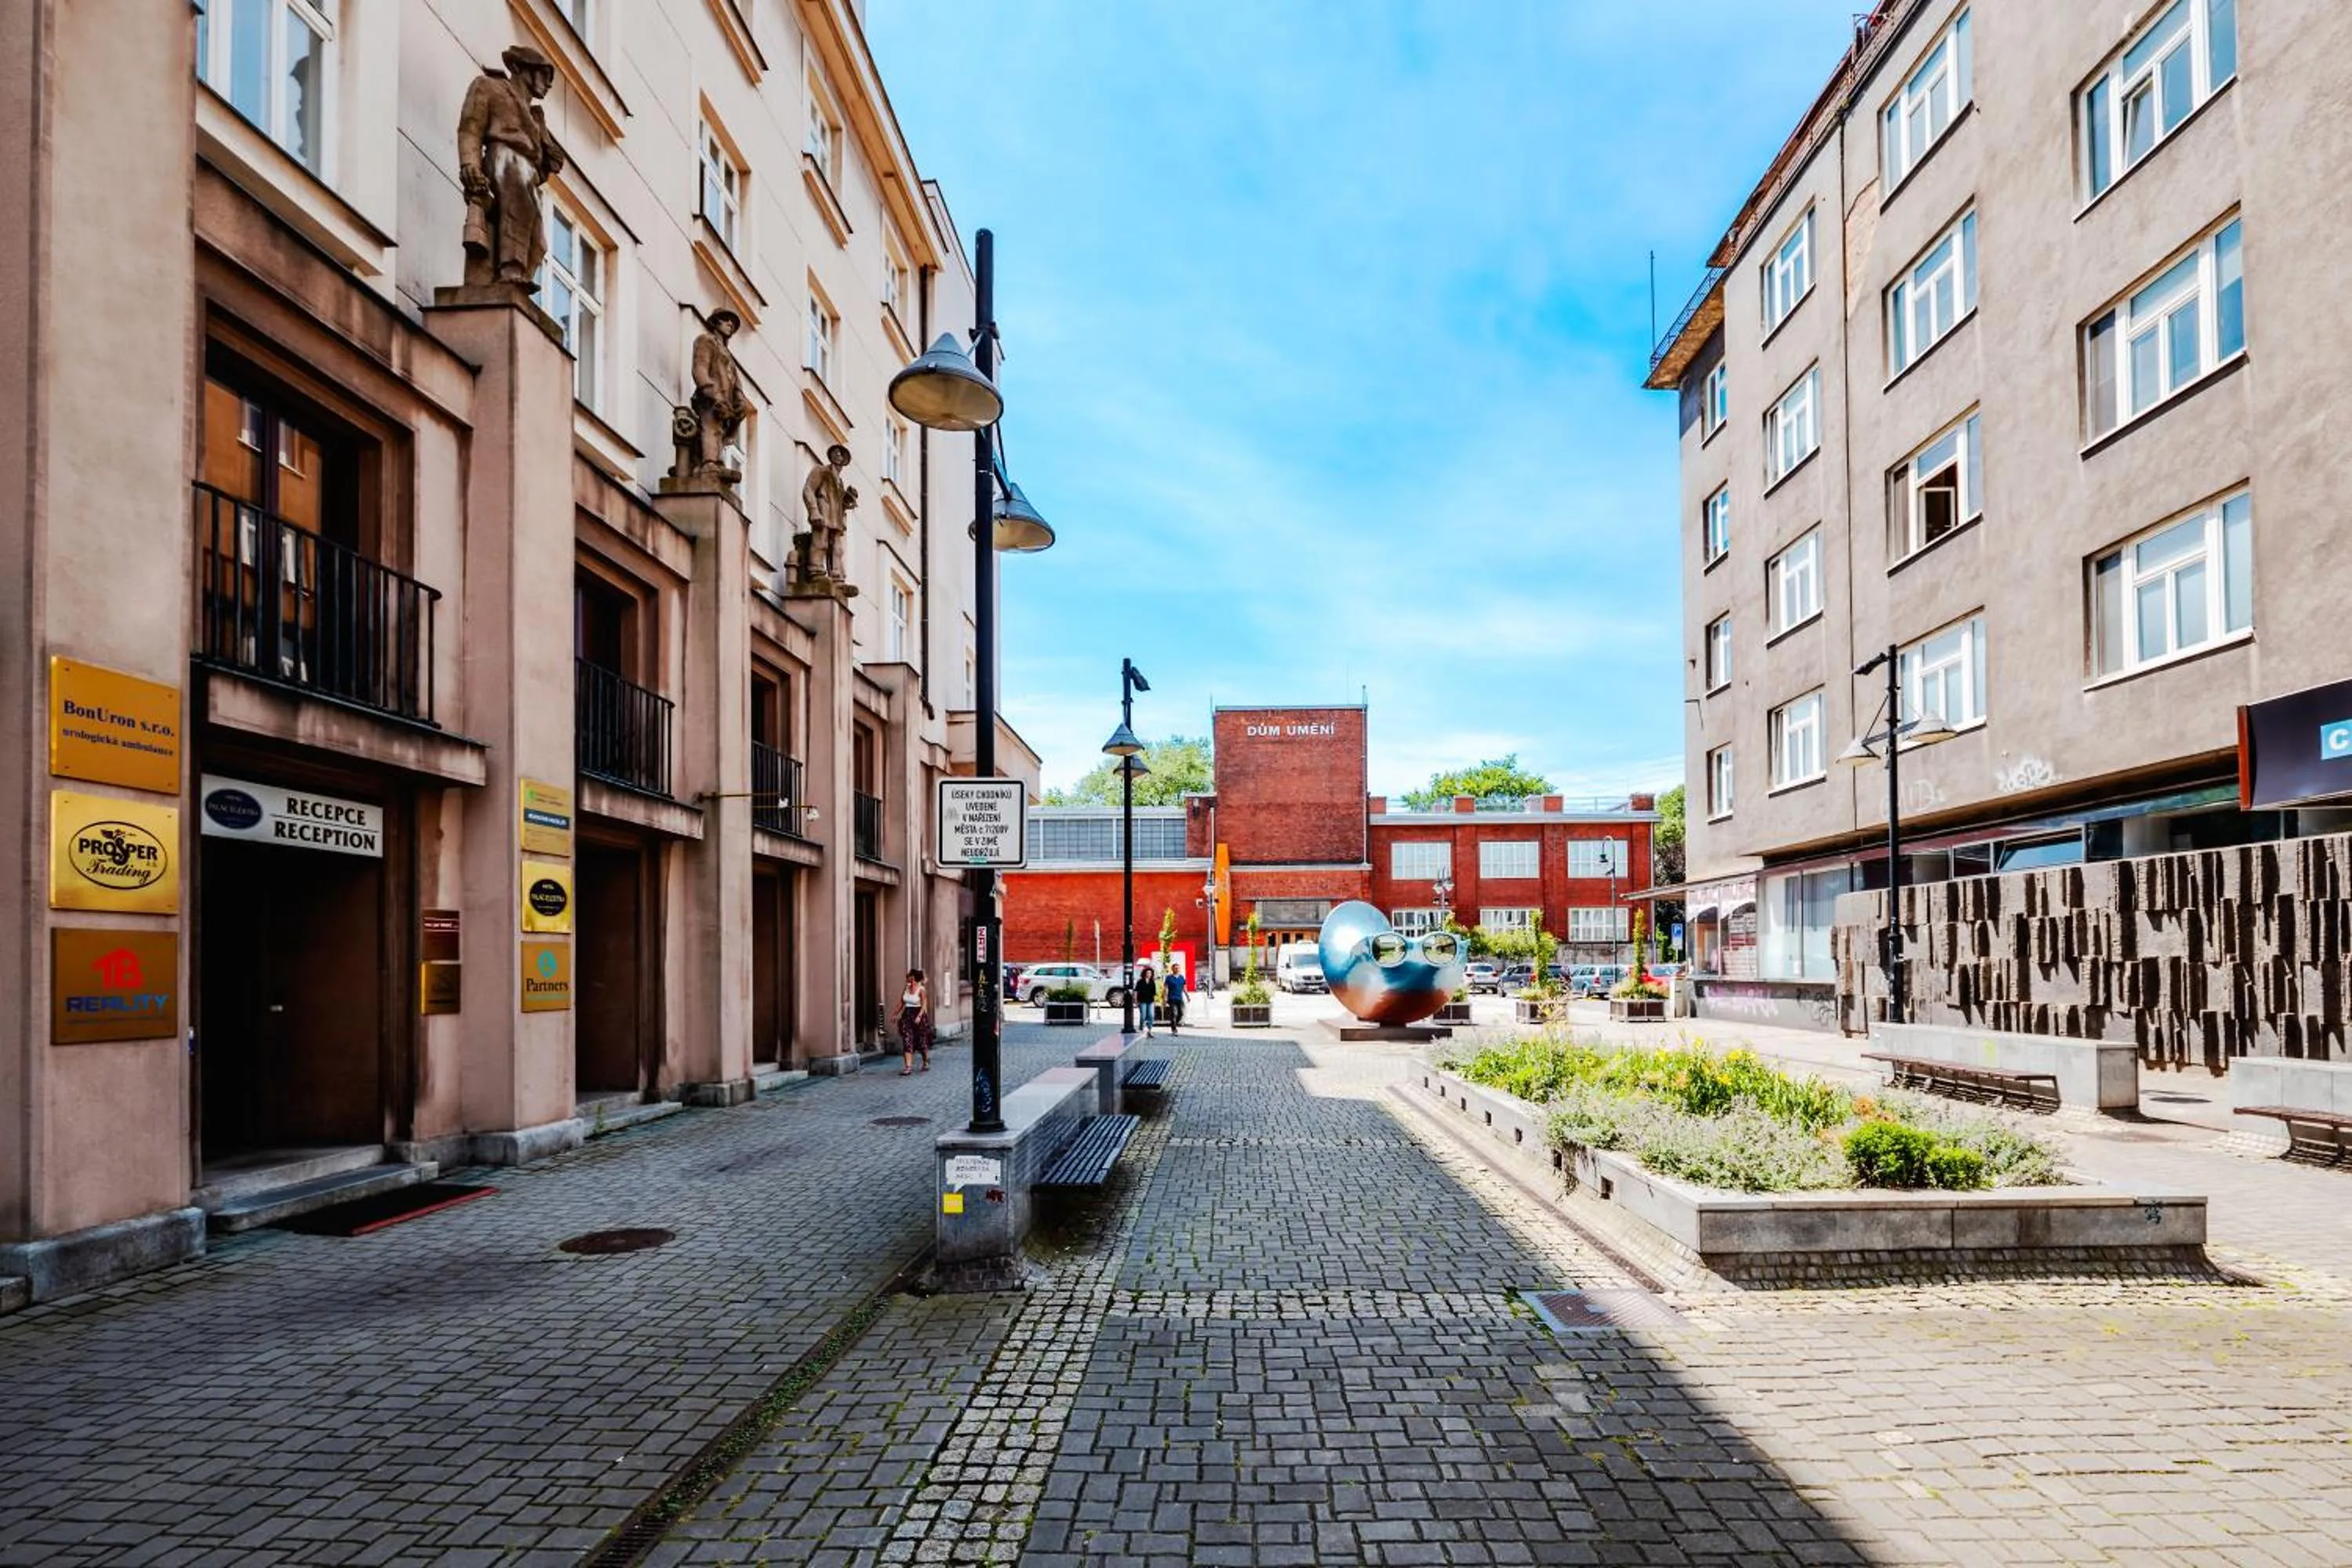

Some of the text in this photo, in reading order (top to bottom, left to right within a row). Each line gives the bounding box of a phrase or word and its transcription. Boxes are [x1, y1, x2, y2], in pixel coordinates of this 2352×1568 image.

[64, 700, 175, 737] BonUron s.r.o.
[1247, 721, 1335, 736] DŮM UMĚNÍ
[951, 788, 974, 799] ÚSEKY
[286, 797, 366, 826] RECEPCE
[274, 821, 376, 851] RECEPTION
[954, 823, 977, 834] MĚSTA
[964, 836, 998, 846] SE V ZIMĚ
[79, 837, 158, 866] PROSPER
[86, 859, 151, 884] Trading
[526, 978, 568, 992] Partners
[67, 994, 168, 1012] REALITY
